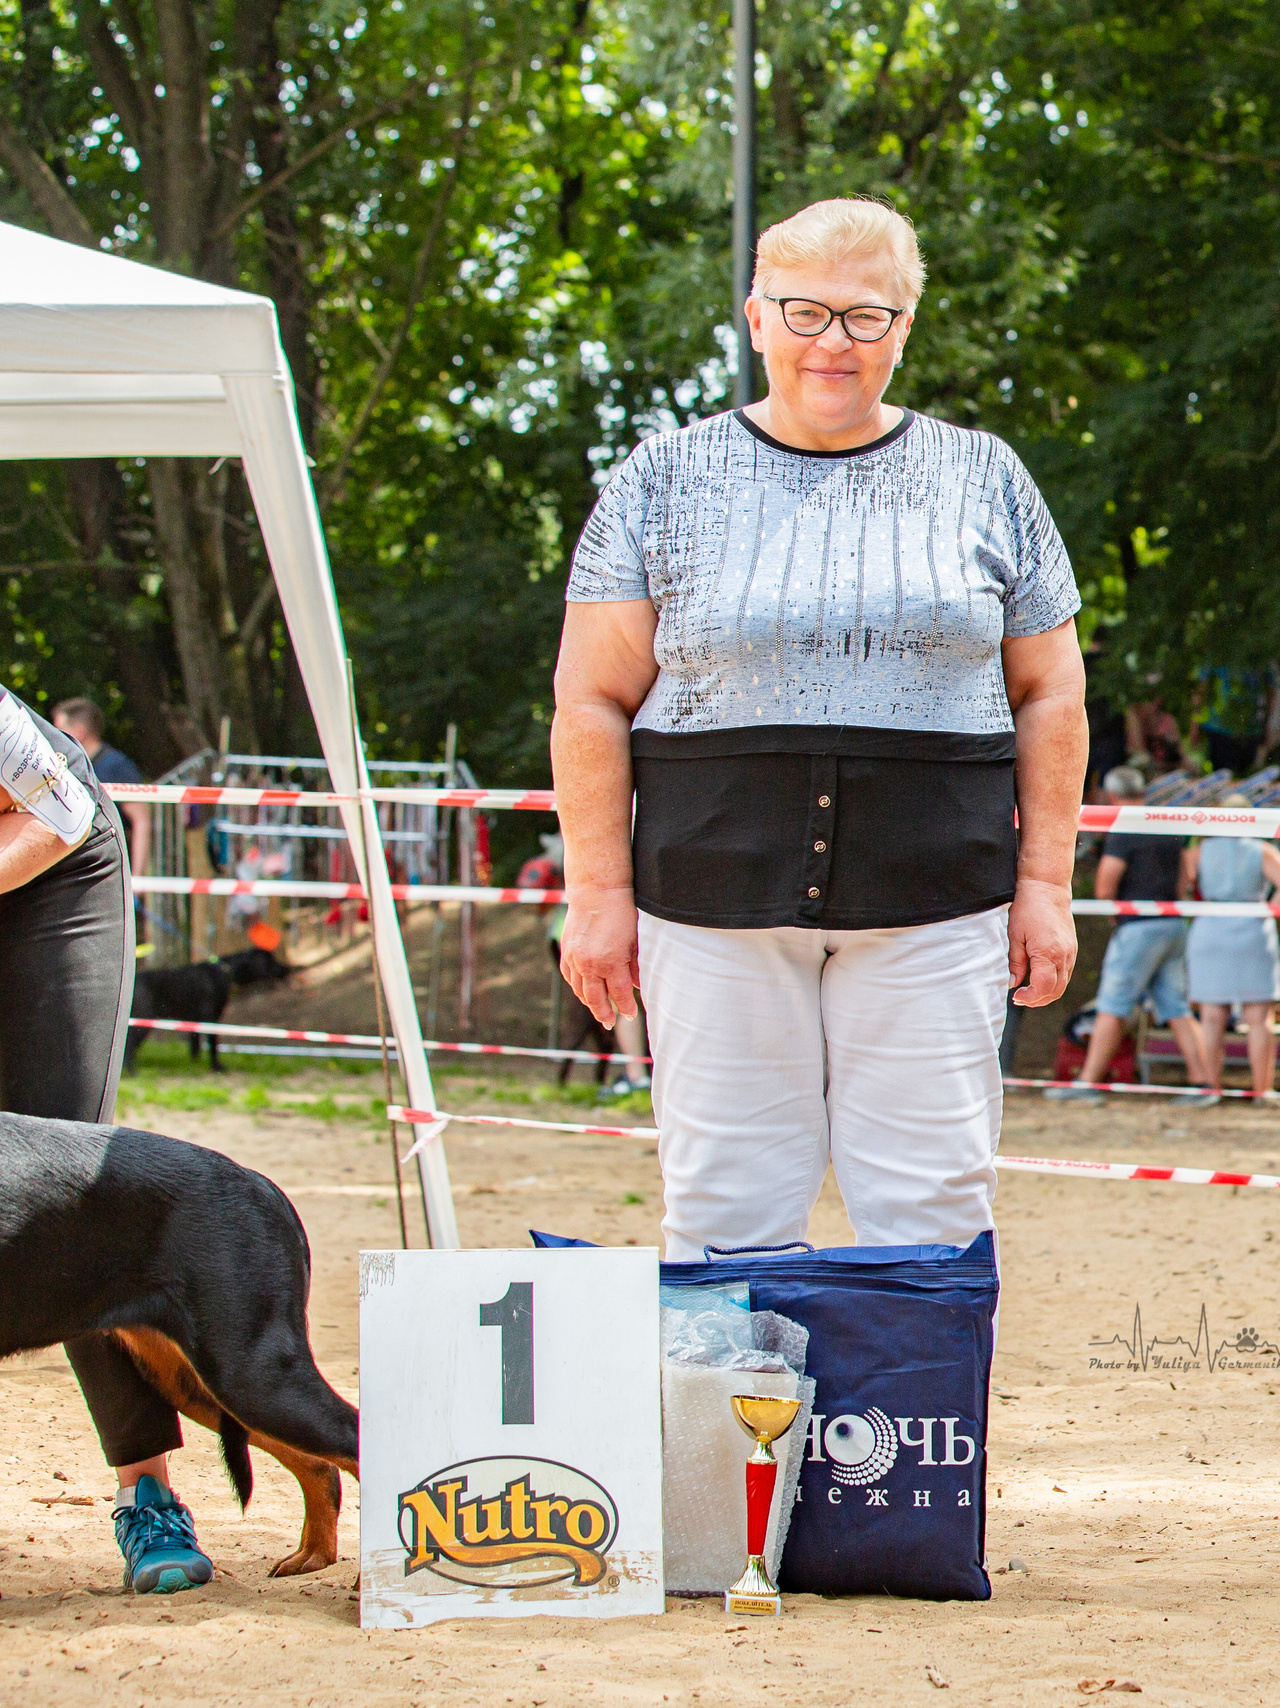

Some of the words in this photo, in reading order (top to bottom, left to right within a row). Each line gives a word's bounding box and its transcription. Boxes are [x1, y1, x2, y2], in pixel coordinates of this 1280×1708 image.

[1144, 812, 1189, 821] СЕРВИС
[1209, 813, 1257, 824] ВОСТОК
[479, 1281, 535, 1425] 1
[399, 1476, 608, 1574] Nutro
